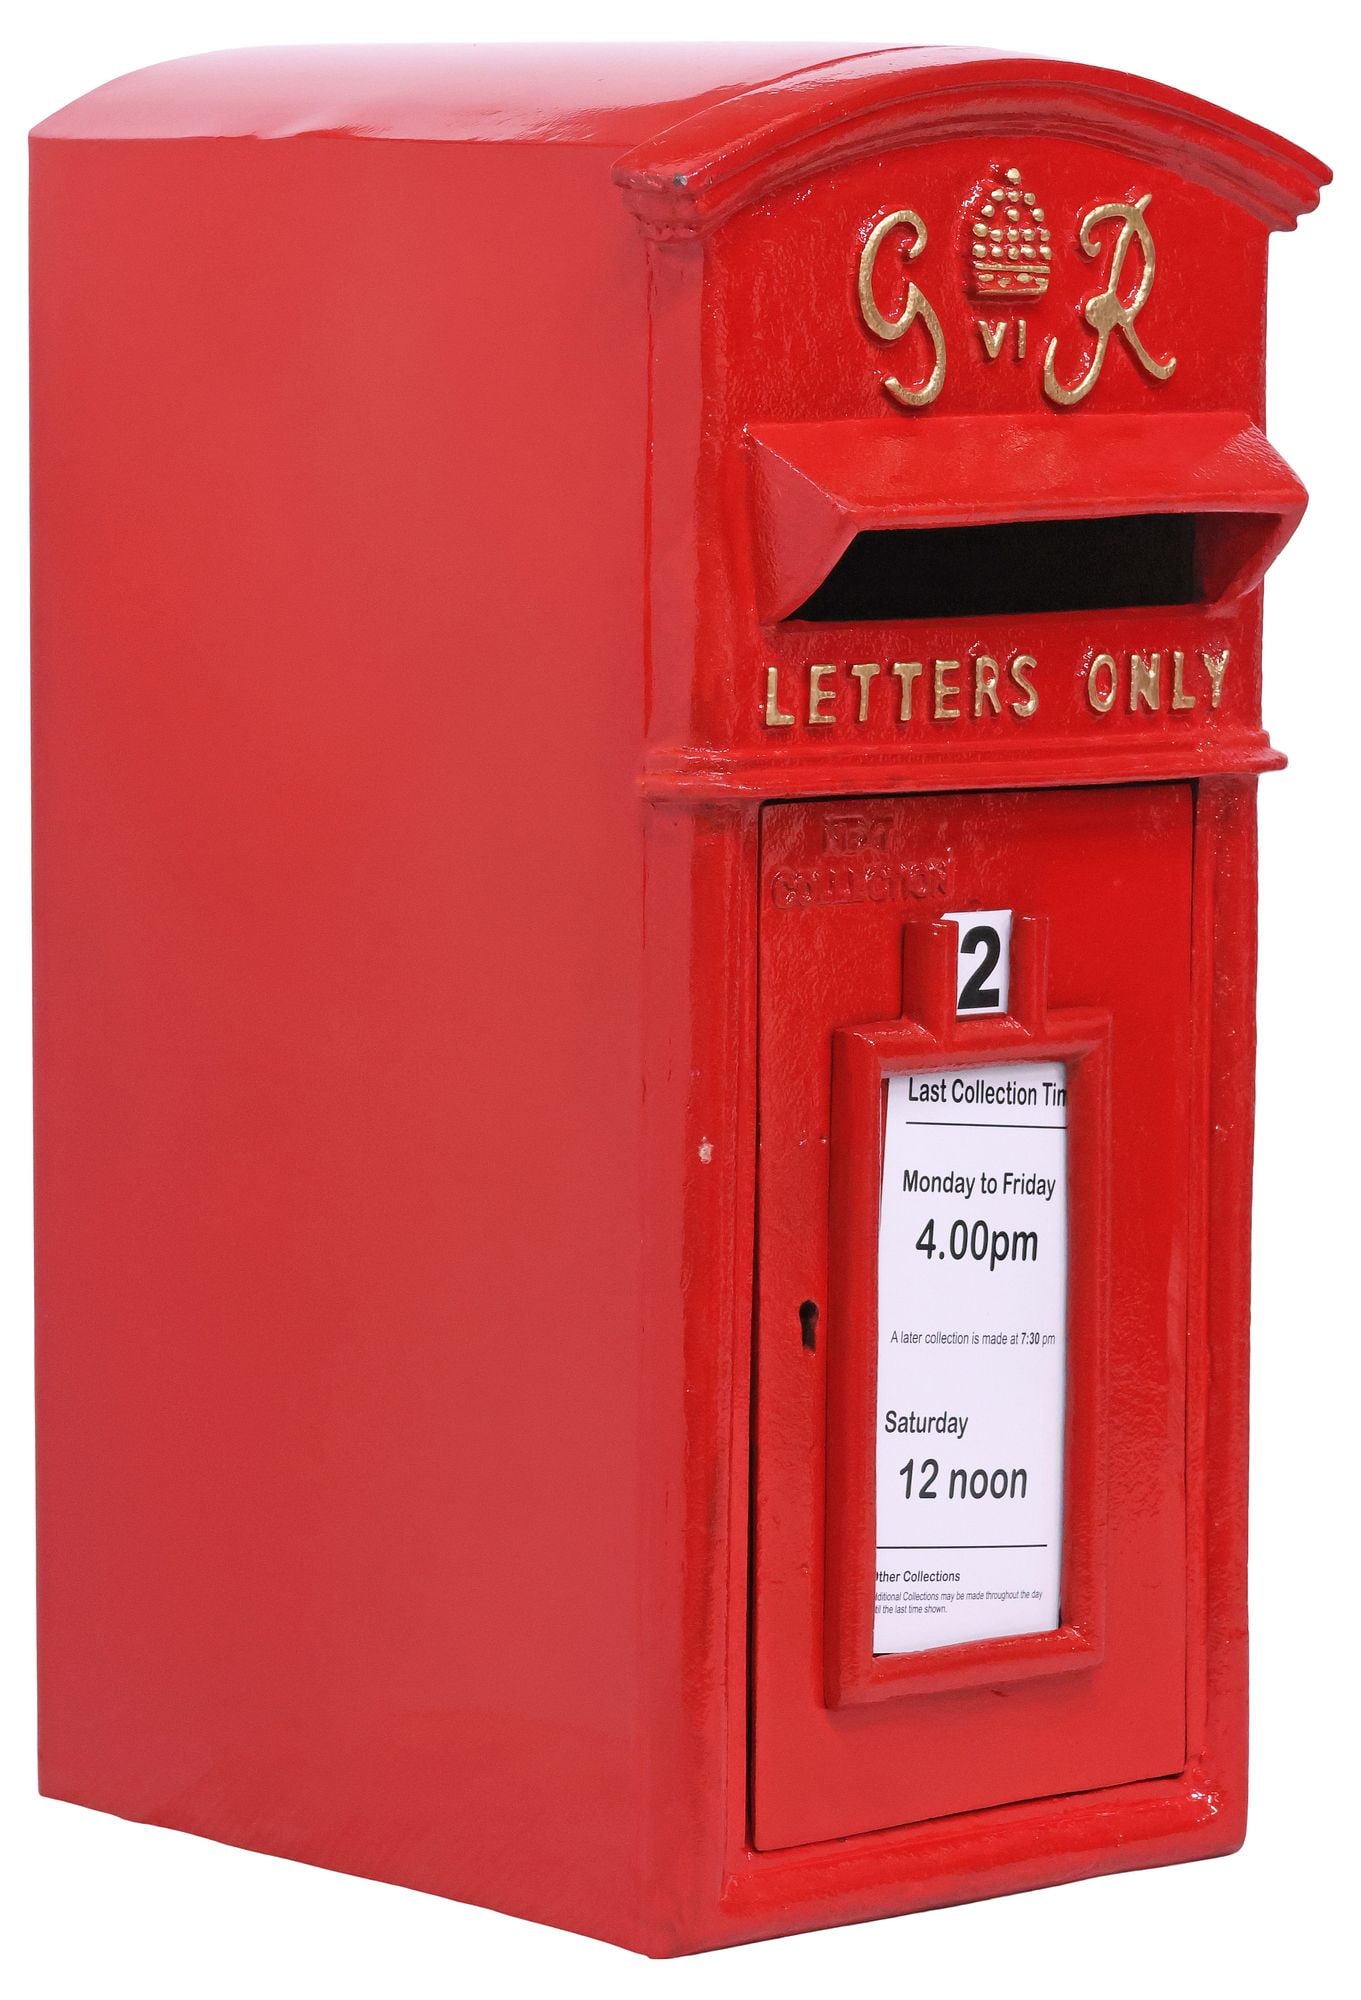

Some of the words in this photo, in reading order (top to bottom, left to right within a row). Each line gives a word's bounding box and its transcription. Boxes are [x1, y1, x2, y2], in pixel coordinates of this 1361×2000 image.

[858, 210, 946, 406] G
[1043, 193, 1177, 405] R
[979, 320, 1027, 359] VI
[766, 656, 1038, 726] LETTERS
[1088, 650, 1230, 713] ONLY
[957, 926, 1001, 1009] 2
[908, 1077, 947, 1102] Last
[951, 1079, 1037, 1106] Collection
[903, 1170, 975, 1199] Monday
[980, 1172, 997, 1194] to
[1003, 1172, 1056, 1201] Friday
[916, 1219, 1038, 1271] 4.00pm
[891, 1331, 898, 1343] A
[901, 1331, 923, 1343] later
[925, 1331, 969, 1344] collection
[972, 1332, 979, 1344] is
[982, 1332, 1007, 1344] made
[1010, 1333, 1018, 1344] at
[1021, 1332, 1040, 1344] 7:30
[1042, 1335, 1055, 1347] pm
[885, 1410, 968, 1439] Saturday
[900, 1459, 939, 1499] 12
[949, 1469, 1027, 1499] noon
[903, 1570, 960, 1582] Collections
[882, 1605, 893, 1614] the
[894, 1605, 907, 1614] last
[909, 1604, 923, 1614] time
[903, 1592, 939, 1601] Collections
[941, 1593, 954, 1602] may
[956, 1592, 965, 1600] be
[966, 1591, 984, 1600] made
[986, 1590, 1019, 1601] throughout
[1020, 1590, 1030, 1599] the
[1031, 1590, 1043, 1600] day
